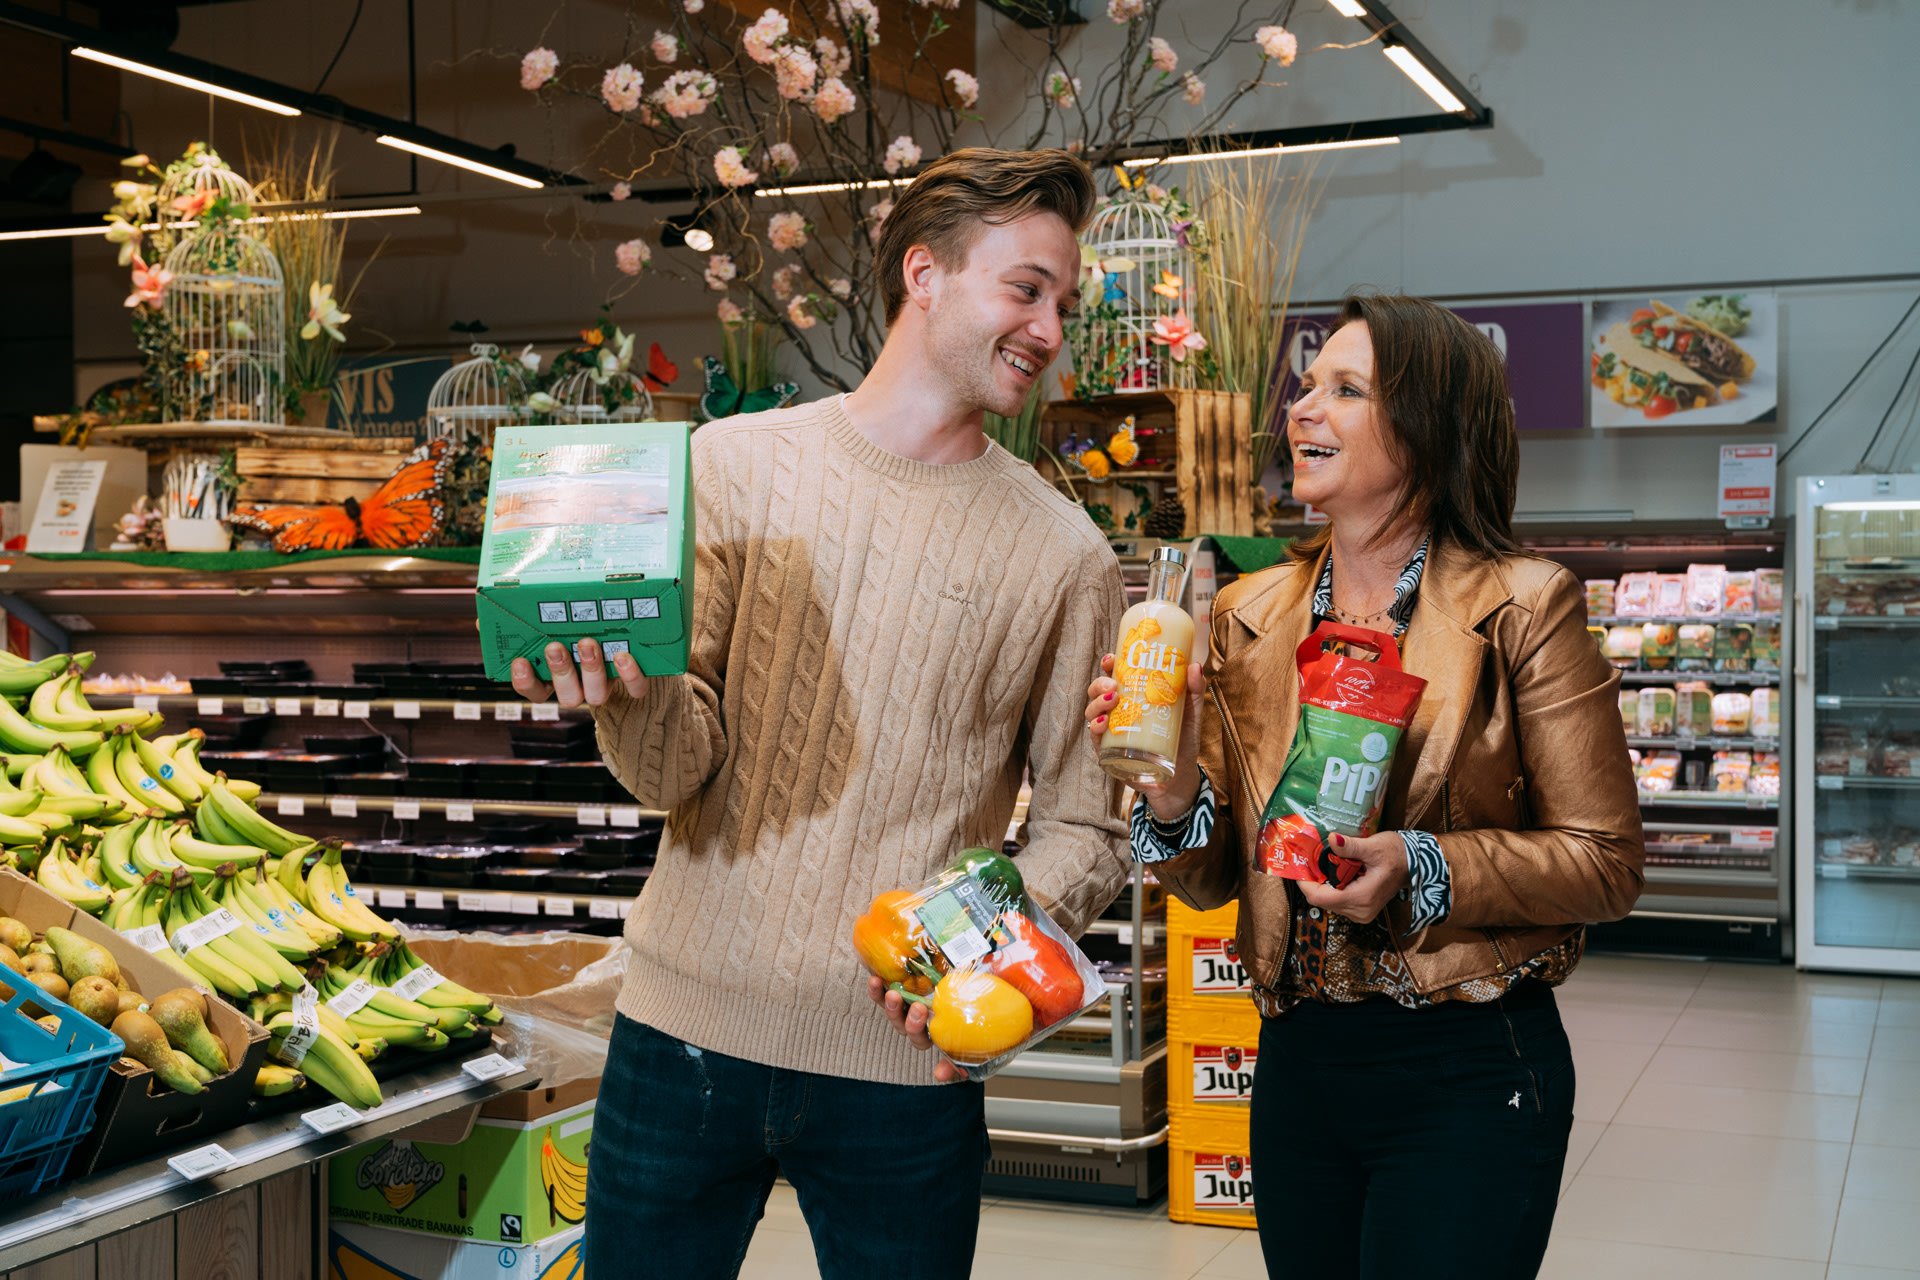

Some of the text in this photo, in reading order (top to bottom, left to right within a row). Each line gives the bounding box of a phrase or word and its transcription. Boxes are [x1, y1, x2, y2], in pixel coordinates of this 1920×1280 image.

[337, 367, 395, 415] VIS
[1273, 848, 1285, 861] 30
[329, 1205, 474, 1237] ORGANIC FAIRTRADE BANANAS
